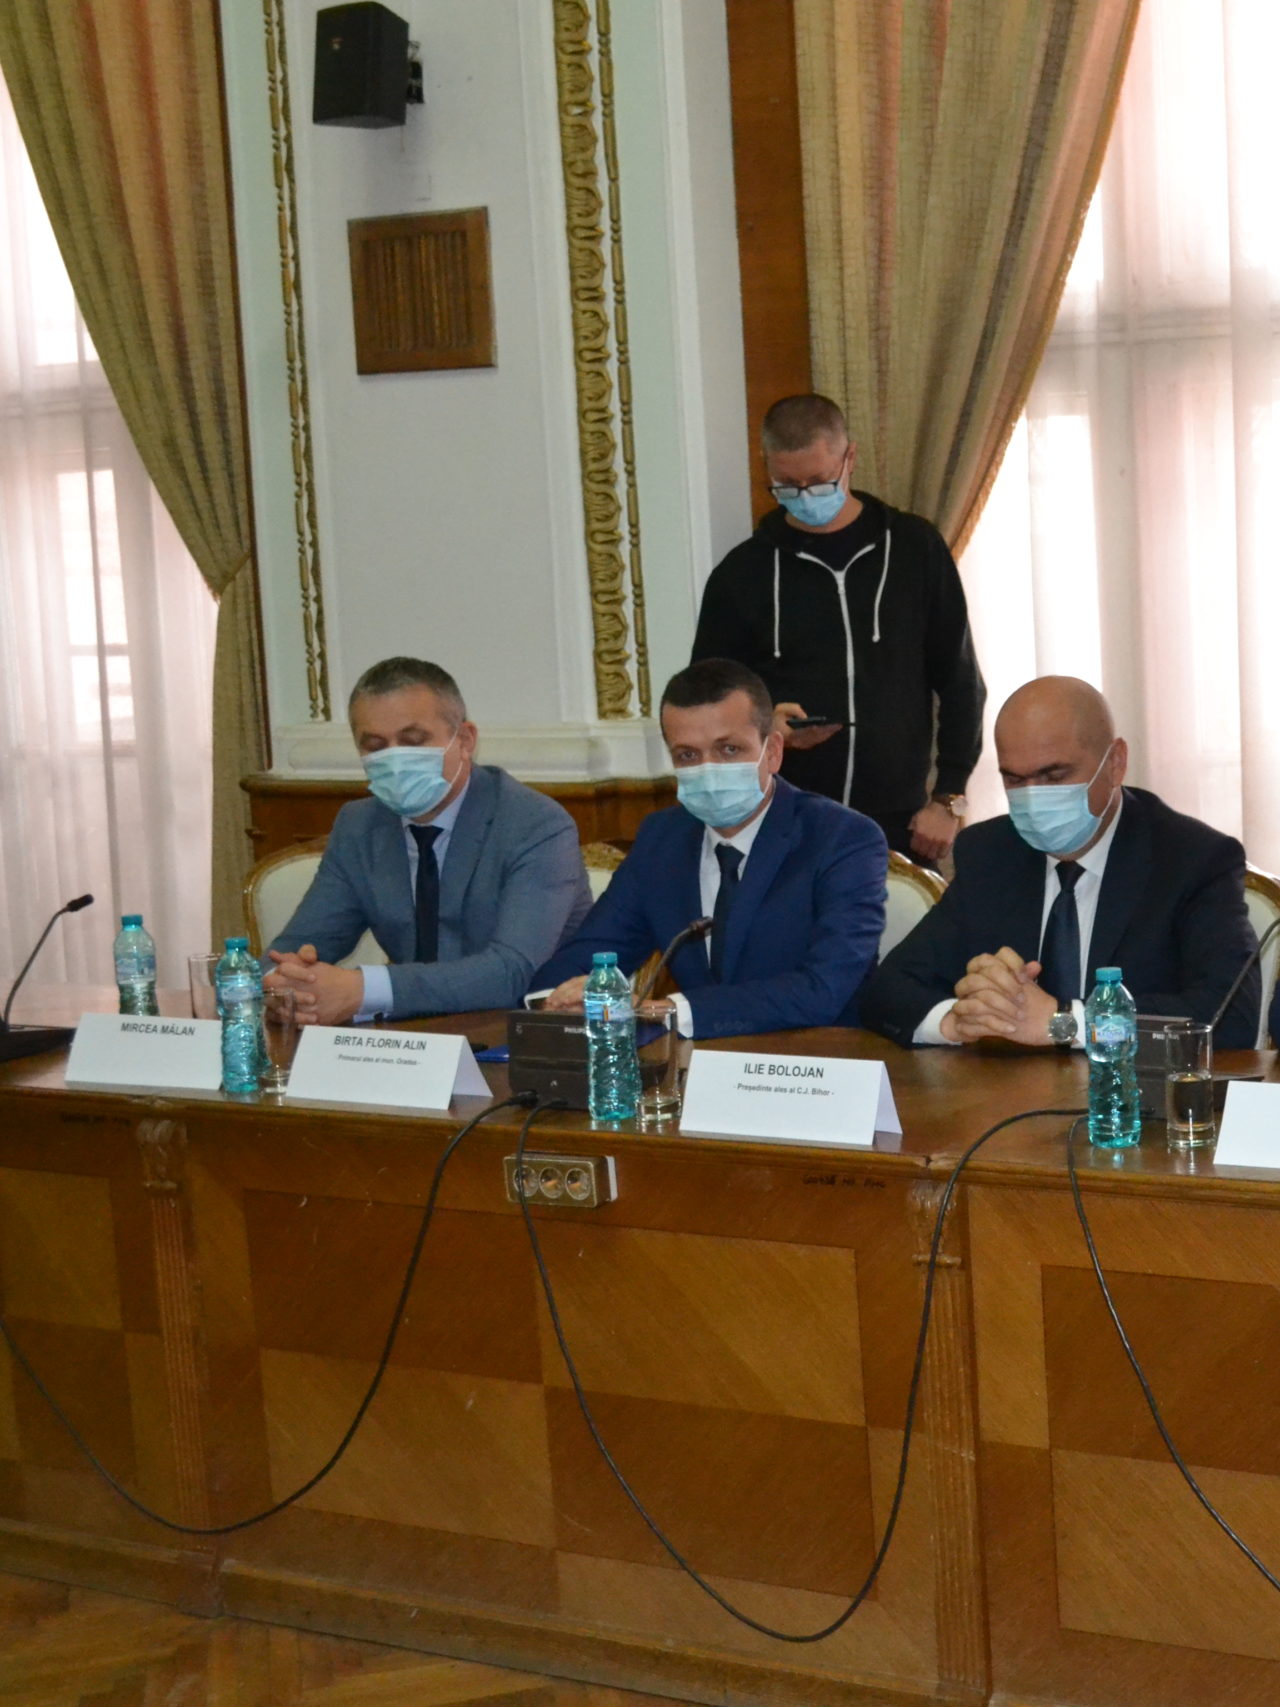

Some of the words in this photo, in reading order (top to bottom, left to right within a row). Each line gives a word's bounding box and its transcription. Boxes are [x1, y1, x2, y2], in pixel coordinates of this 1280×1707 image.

[120, 1022, 158, 1034] MIRCEA
[334, 1035, 363, 1047] BIRTA
[365, 1037, 402, 1049] FLORIN
[403, 1040, 427, 1051] ALIN
[744, 1063, 766, 1075] ILIE
[768, 1064, 824, 1079] BOLOJAN
[789, 1086, 795, 1094] al
[797, 1087, 809, 1095] C.J.
[811, 1088, 830, 1096] Bihor
